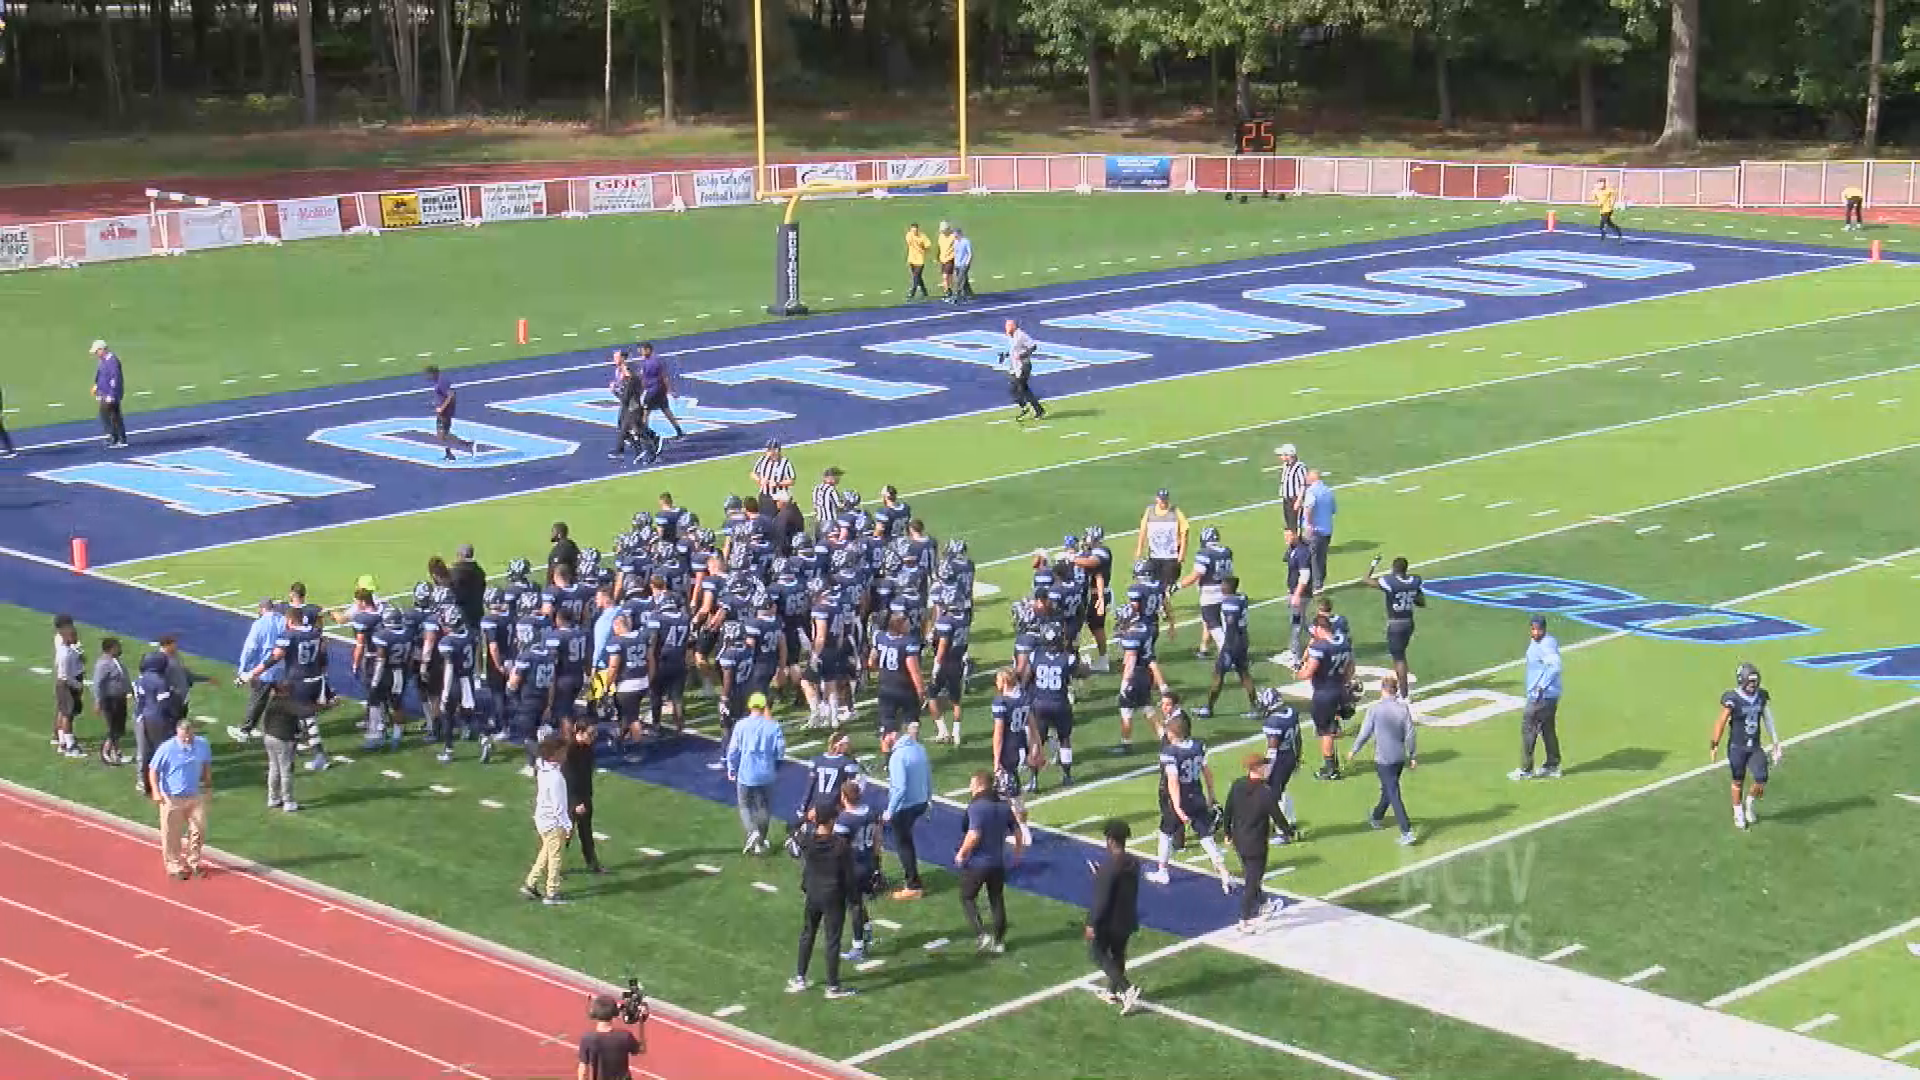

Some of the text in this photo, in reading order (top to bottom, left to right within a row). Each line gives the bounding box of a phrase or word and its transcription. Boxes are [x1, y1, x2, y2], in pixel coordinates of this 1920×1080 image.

[1242, 123, 1274, 152] 25
[595, 178, 639, 190] GNC
[28, 248, 1697, 516] NORTHWOOD
[568, 636, 587, 662] 91
[664, 626, 689, 647] 47
[877, 643, 899, 671] 78
[1036, 664, 1062, 690] 96
[816, 767, 839, 793] 17
